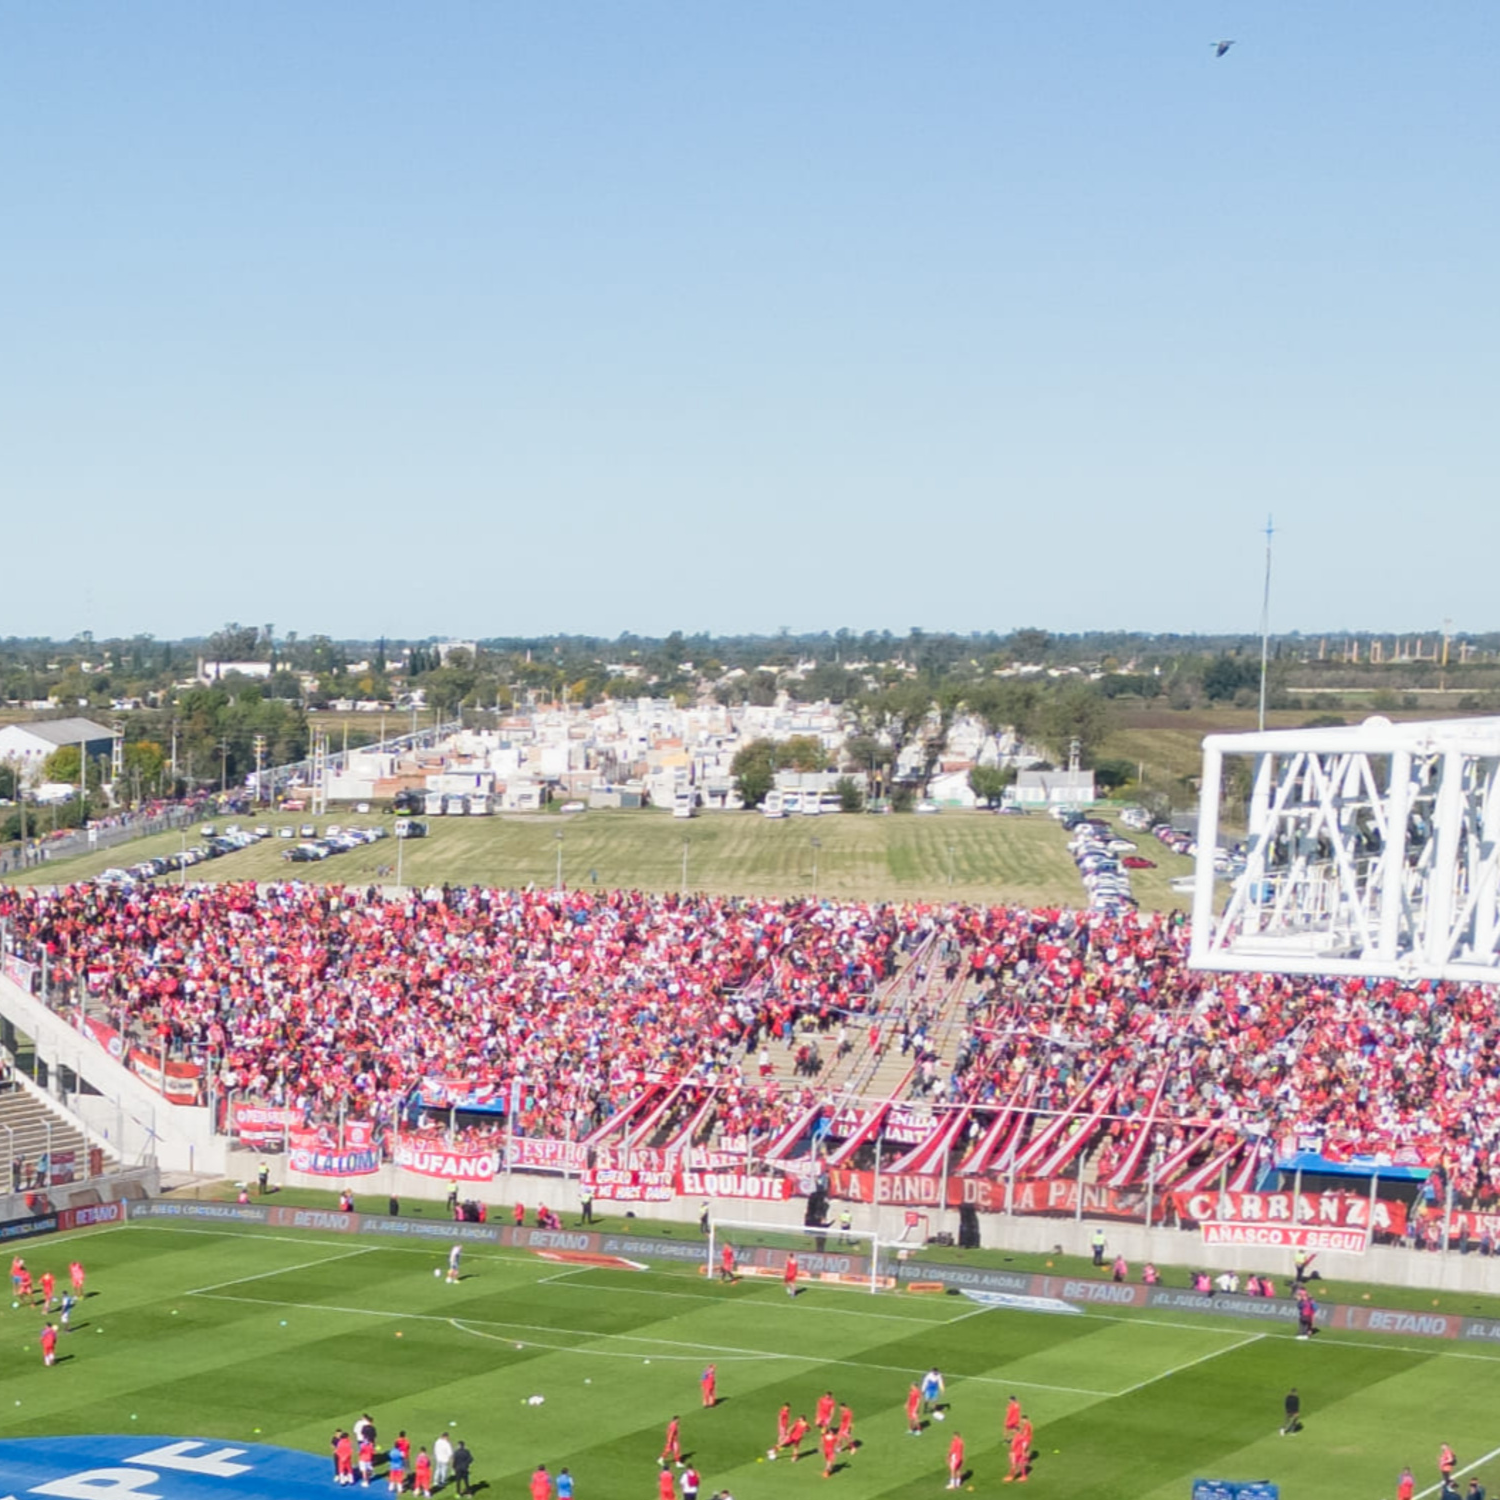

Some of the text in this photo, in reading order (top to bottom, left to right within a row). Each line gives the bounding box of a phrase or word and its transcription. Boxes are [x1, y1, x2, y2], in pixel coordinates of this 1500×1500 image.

[313, 1152, 333, 1172] LA
[401, 1148, 493, 1177] BUFANO
[831, 1170, 862, 1199] LA
[963, 1178, 992, 1206] DE
[294, 1211, 350, 1229] BETANO
[1189, 1193, 1391, 1229] CARRANZA
[529, 1231, 588, 1250] BETANO
[1207, 1224, 1283, 1243] AÑASCO
[1288, 1230, 1301, 1245] Y
[795, 1253, 850, 1273] ETANO
[1063, 1281, 1135, 1302] BETANO
[1368, 1310, 1446, 1334] BETANO
